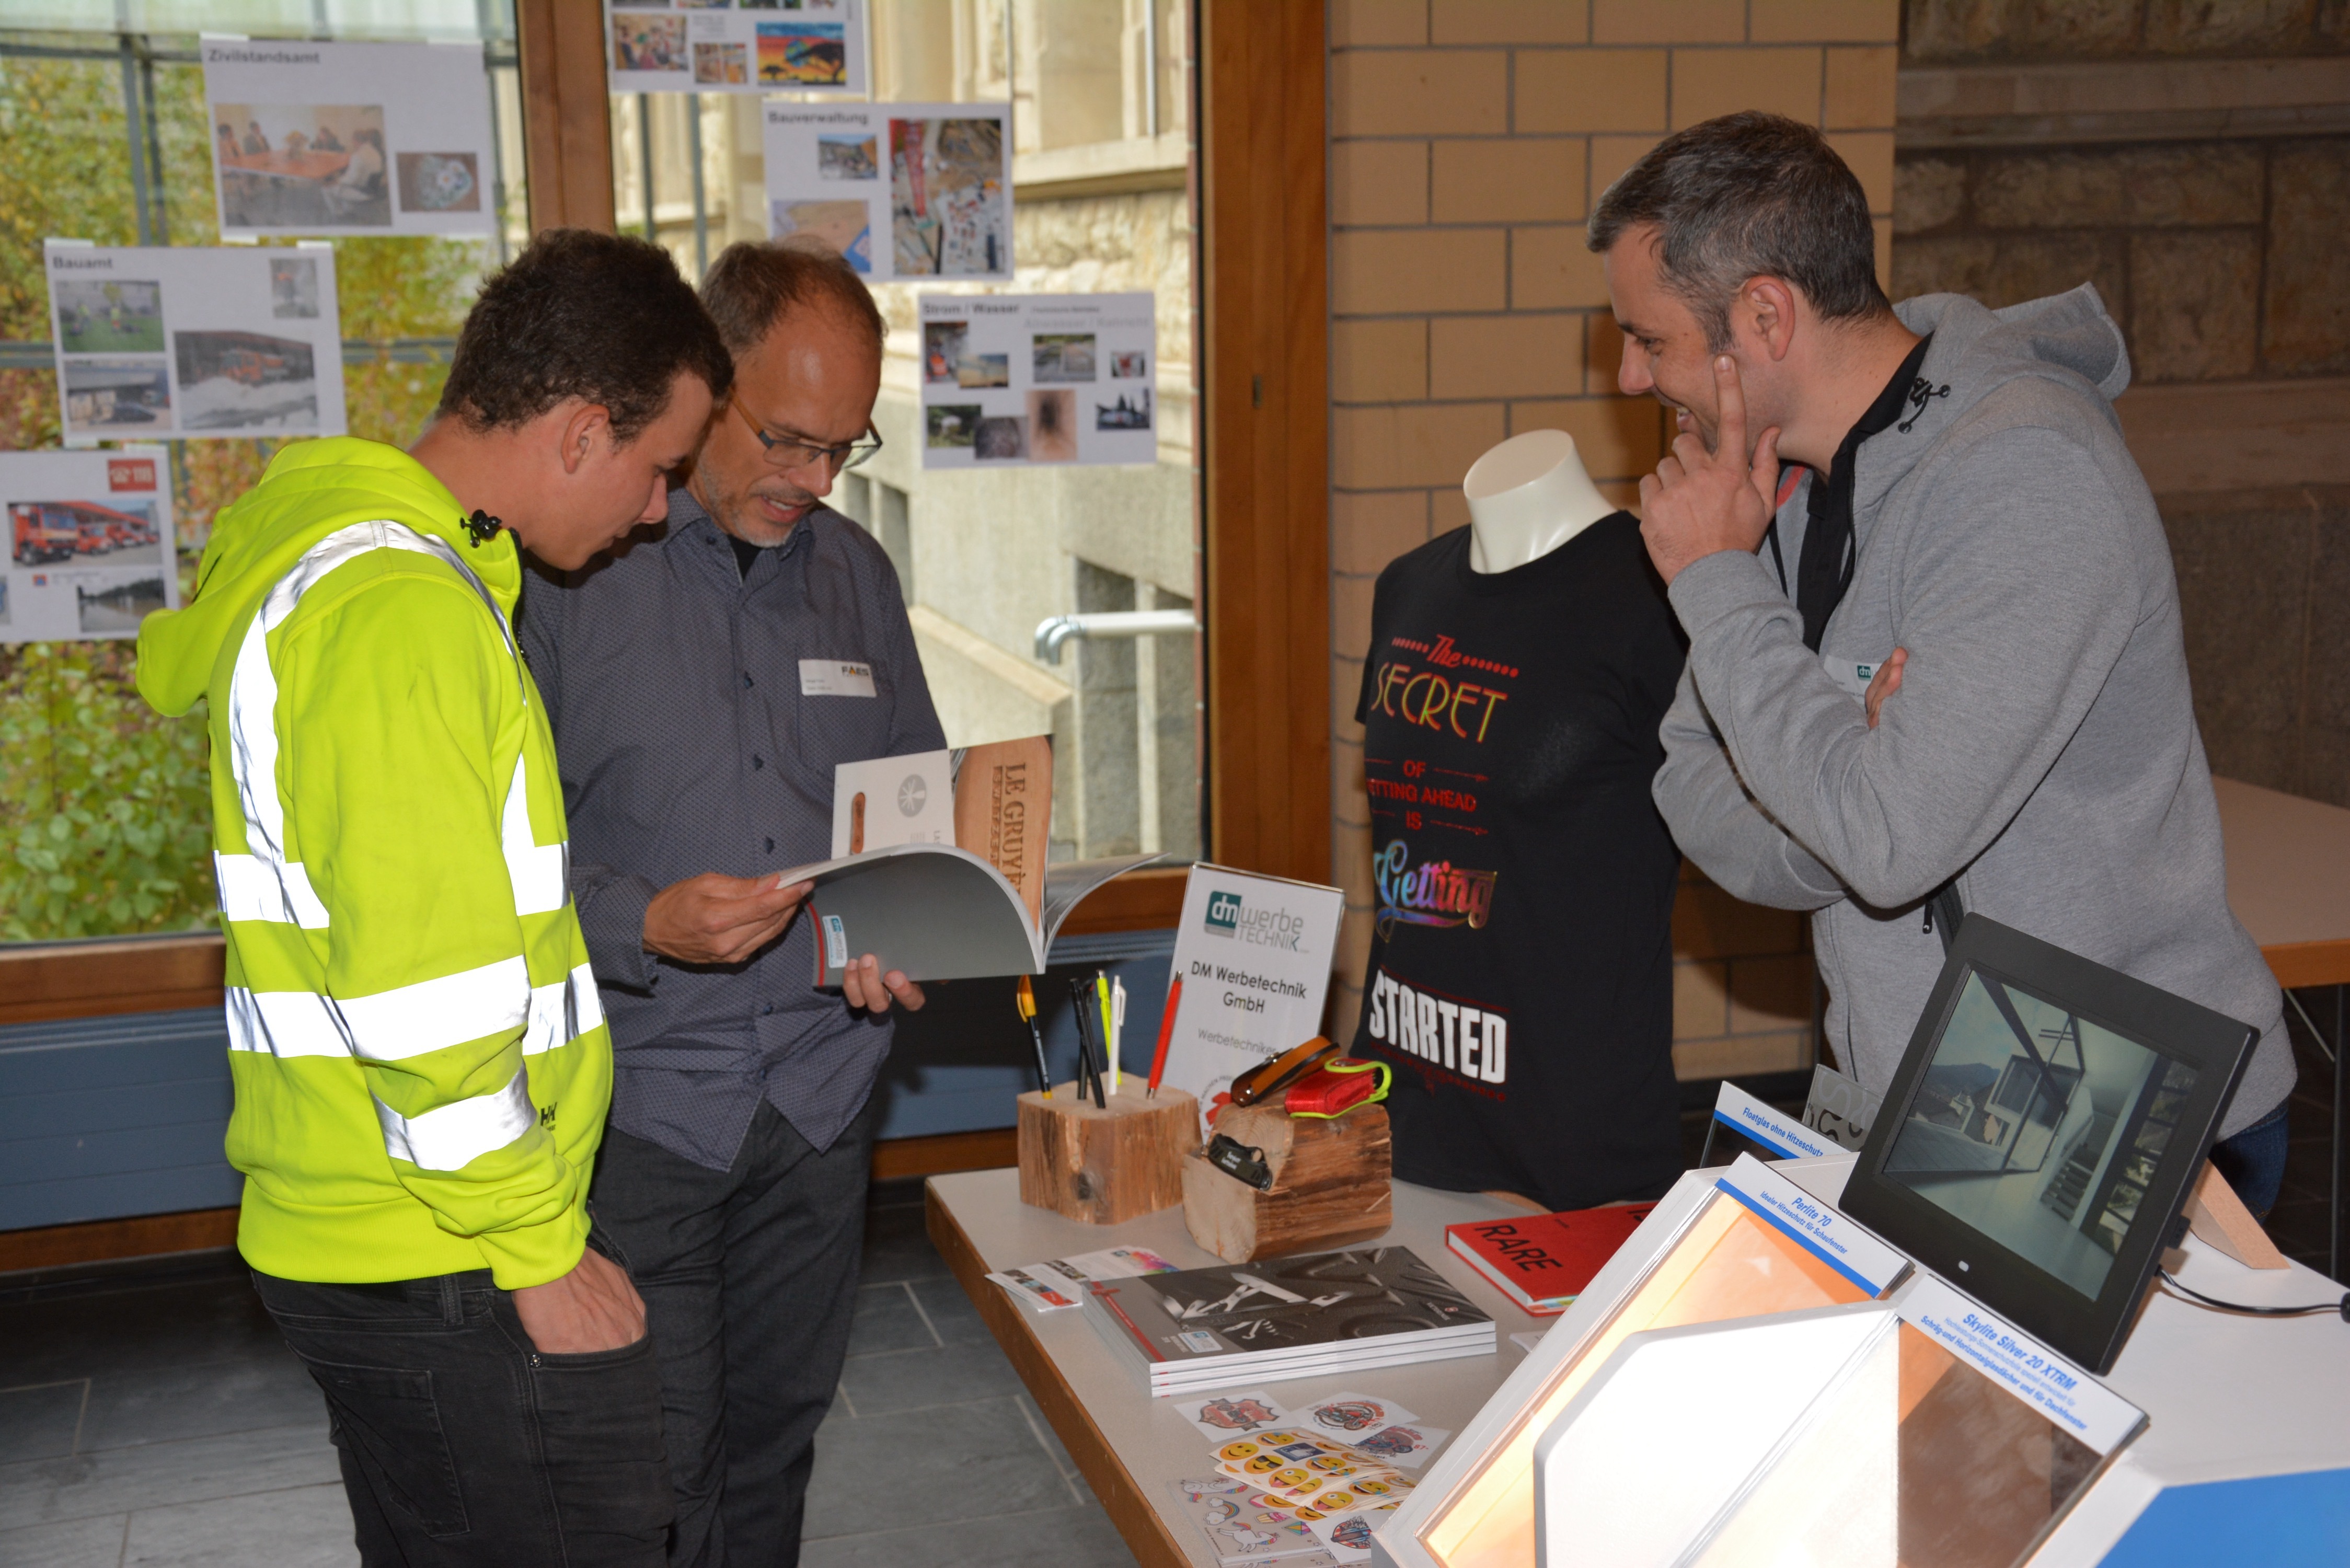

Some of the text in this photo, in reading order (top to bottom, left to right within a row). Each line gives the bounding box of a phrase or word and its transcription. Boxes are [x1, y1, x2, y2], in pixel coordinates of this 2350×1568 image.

[208, 49, 320, 63] Zivilstandsamt
[768, 111, 868, 125] Bauverwaltung
[52, 256, 112, 269] Bauamt
[1426, 633, 1462, 667] The
[1370, 662, 1508, 743] SECRET
[1403, 759, 1427, 778] OF
[1424, 787, 1477, 813] AHEAD
[1001, 762, 1026, 895] LE GRUYÈ
[1406, 811, 1422, 831] IS
[1374, 839, 1497, 939] Getting
[1239, 924, 1299, 952] TECHNIK
[1191, 961, 1307, 999] DM Werbetechnik
[1223, 991, 1265, 1013] GmbH
[1368, 969, 1507, 1085] STARTED
[1743, 1107, 1824, 1157] Floatglas ohne Hitzeschutz
[1760, 1191, 1848, 1254] Idealer Hitzeschutz für Schaufenster
[1791, 1197, 1832, 1227] Perlite 70
[1474, 1224, 1563, 1272] RARE
[1963, 1313, 2078, 1391] Skylite Silver 20 XTRM
[2019, 1383, 2035, 1395] und
[2033, 1390, 2045, 1402] für
[2044, 1398, 2088, 1430] Dachfenster
